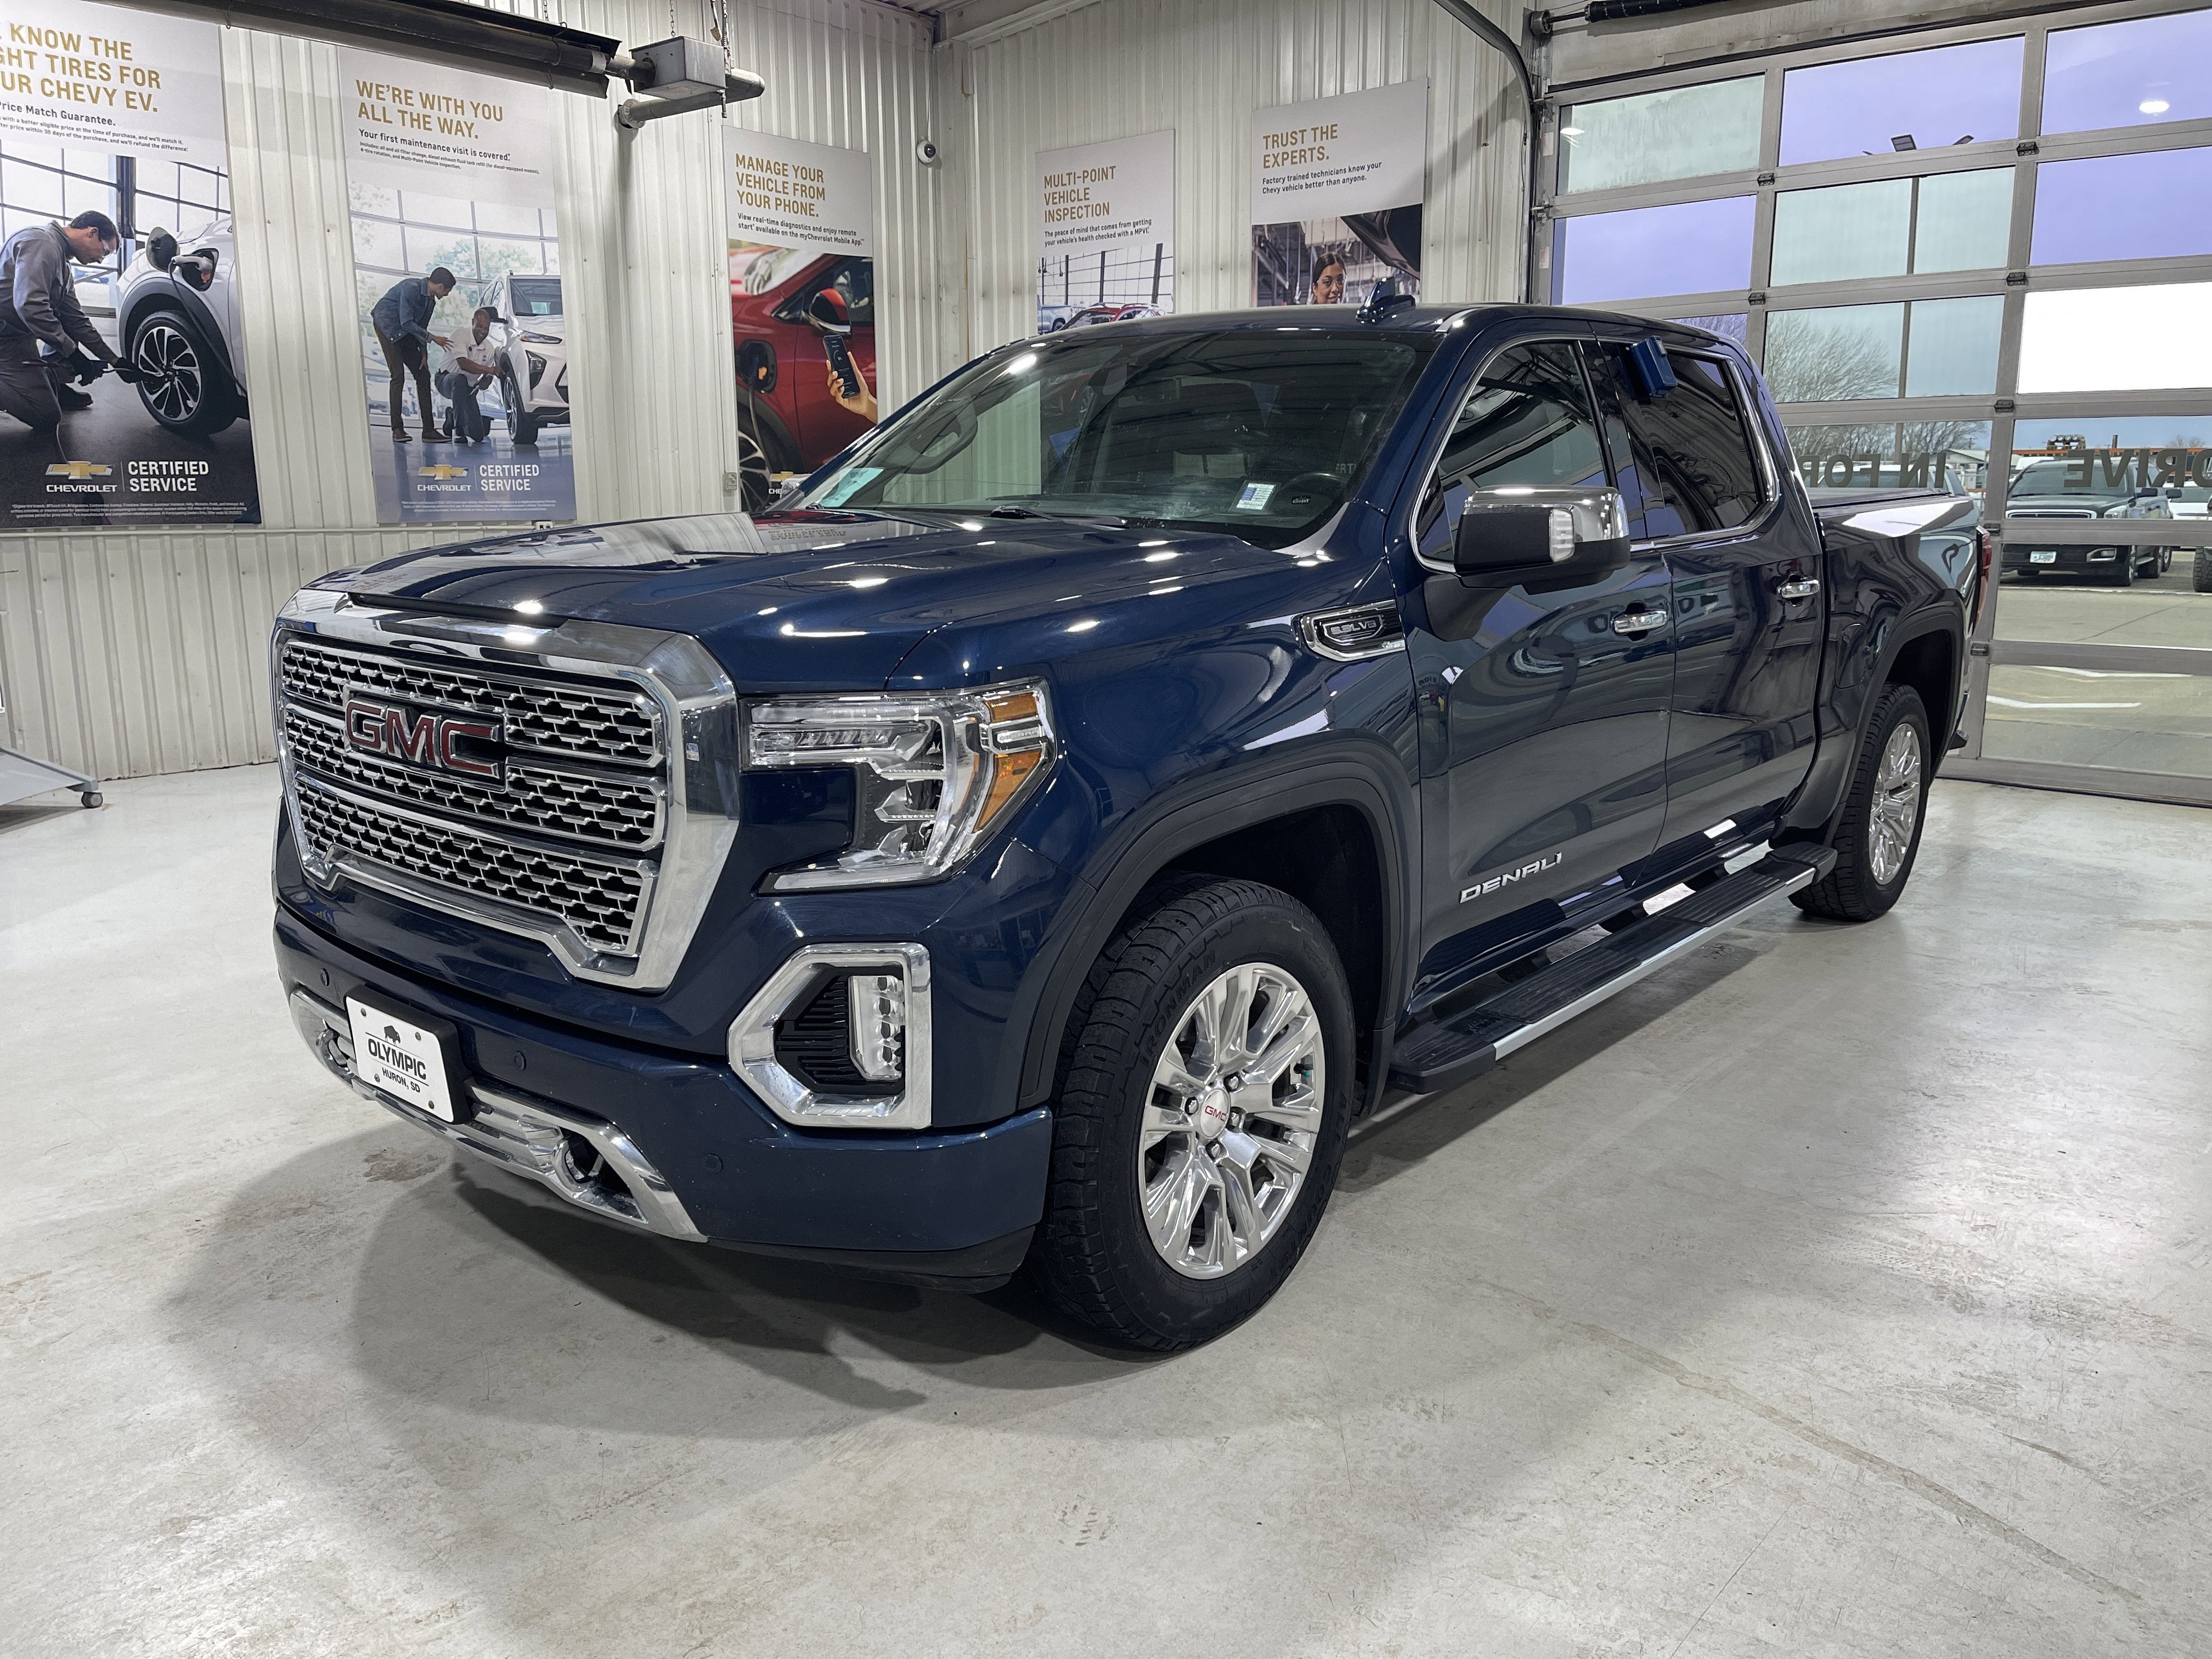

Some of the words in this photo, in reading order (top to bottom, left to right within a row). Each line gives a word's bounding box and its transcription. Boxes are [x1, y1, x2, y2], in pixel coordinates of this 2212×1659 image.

[10, 22, 81, 53] KNOW
[89, 36, 133, 61] THE
[45, 54, 111, 82] TIRES
[120, 65, 161, 89] FOR
[41, 78, 117, 106] CHEVY
[125, 90, 157, 112] EV.
[356, 79, 414, 107] WE'RE
[419, 91, 465, 116] WITH
[470, 100, 503, 122] YOU
[0, 101, 22, 112] rice
[25, 105, 58, 118] Match
[60, 110, 116, 126] Guarantee.
[358, 102, 393, 125] ALL
[397, 109, 432, 131] THE
[437, 116, 478, 139] WAY.
[112, 131, 137, 140] purchase,
[358, 128, 378, 140] Your
[380, 133, 398, 144] first
[400, 138, 450, 153] maintenance
[452, 145, 469, 155] visit
[1262, 128, 1307, 150] TRUST
[1311, 123, 1338, 143] THE
[735, 153, 789, 177] MANAGE
[792, 165, 824, 183] YOUR
[1263, 145, 1329, 169] EXPERTS.
[1044, 165, 1116, 189] MULTI-POINT
[1262, 176, 1286, 185] Factory
[1287, 172, 1310, 182] trained
[1311, 167, 1347, 178] technicians
[1348, 165, 1365, 173] know
[1367, 161, 1382, 172] your
[1262, 185, 1281, 195] Chevy
[1282, 183, 1304, 192] vehicle
[1305, 180, 1324, 189] better
[1325, 178, 1340, 186] than
[1342, 175, 1367, 184] anyone.
[736, 171, 789, 195] VEHICLE
[793, 182, 825, 201] FROM
[1044, 187, 1090, 206] VEHICLE
[737, 190, 771, 210] YOUR
[775, 197, 819, 218] PHONE.
[1045, 202, 1110, 223] INSPECTION
[737, 212, 752, 222] View
[753, 216, 779, 226] real-time
[780, 219, 811, 232] diagnostics
[812, 224, 822, 233] and
[823, 226, 837, 236] enjoy
[838, 228, 856, 236] remote
[755, 225, 780, 235] available
[789, 230, 798, 238] the
[799, 232, 833, 242] myChevrolet
[834, 236, 850, 245] Mobile
[1054, 229, 1069, 238] peace
[1101, 223, 1118, 231] comes
[1132, 218, 1152, 229] getting
[1044, 239, 1056, 248] your
[1057, 236, 1077, 245] vehicle's
[1095, 232, 1116, 240] checked
[1117, 230, 1129, 238] with
[128, 461, 209, 476] CERTIFIED
[479, 464, 539, 477] CERTIFIED
[46, 484, 117, 493] CHEVROLET
[129, 477, 197, 492] SERVICE
[481, 479, 531, 491] SERVICE
[346, 698, 501, 778] GMC
[1459, 851, 1562, 904] DENALI
[1140, 949, 1216, 1068] IRONMAN
[368, 1038, 426, 1080] OLYMPIC
[381, 1067, 409, 1090] HURON,
[410, 1080, 420, 1093] SD
[1205, 1105, 1227, 1121] GMC
